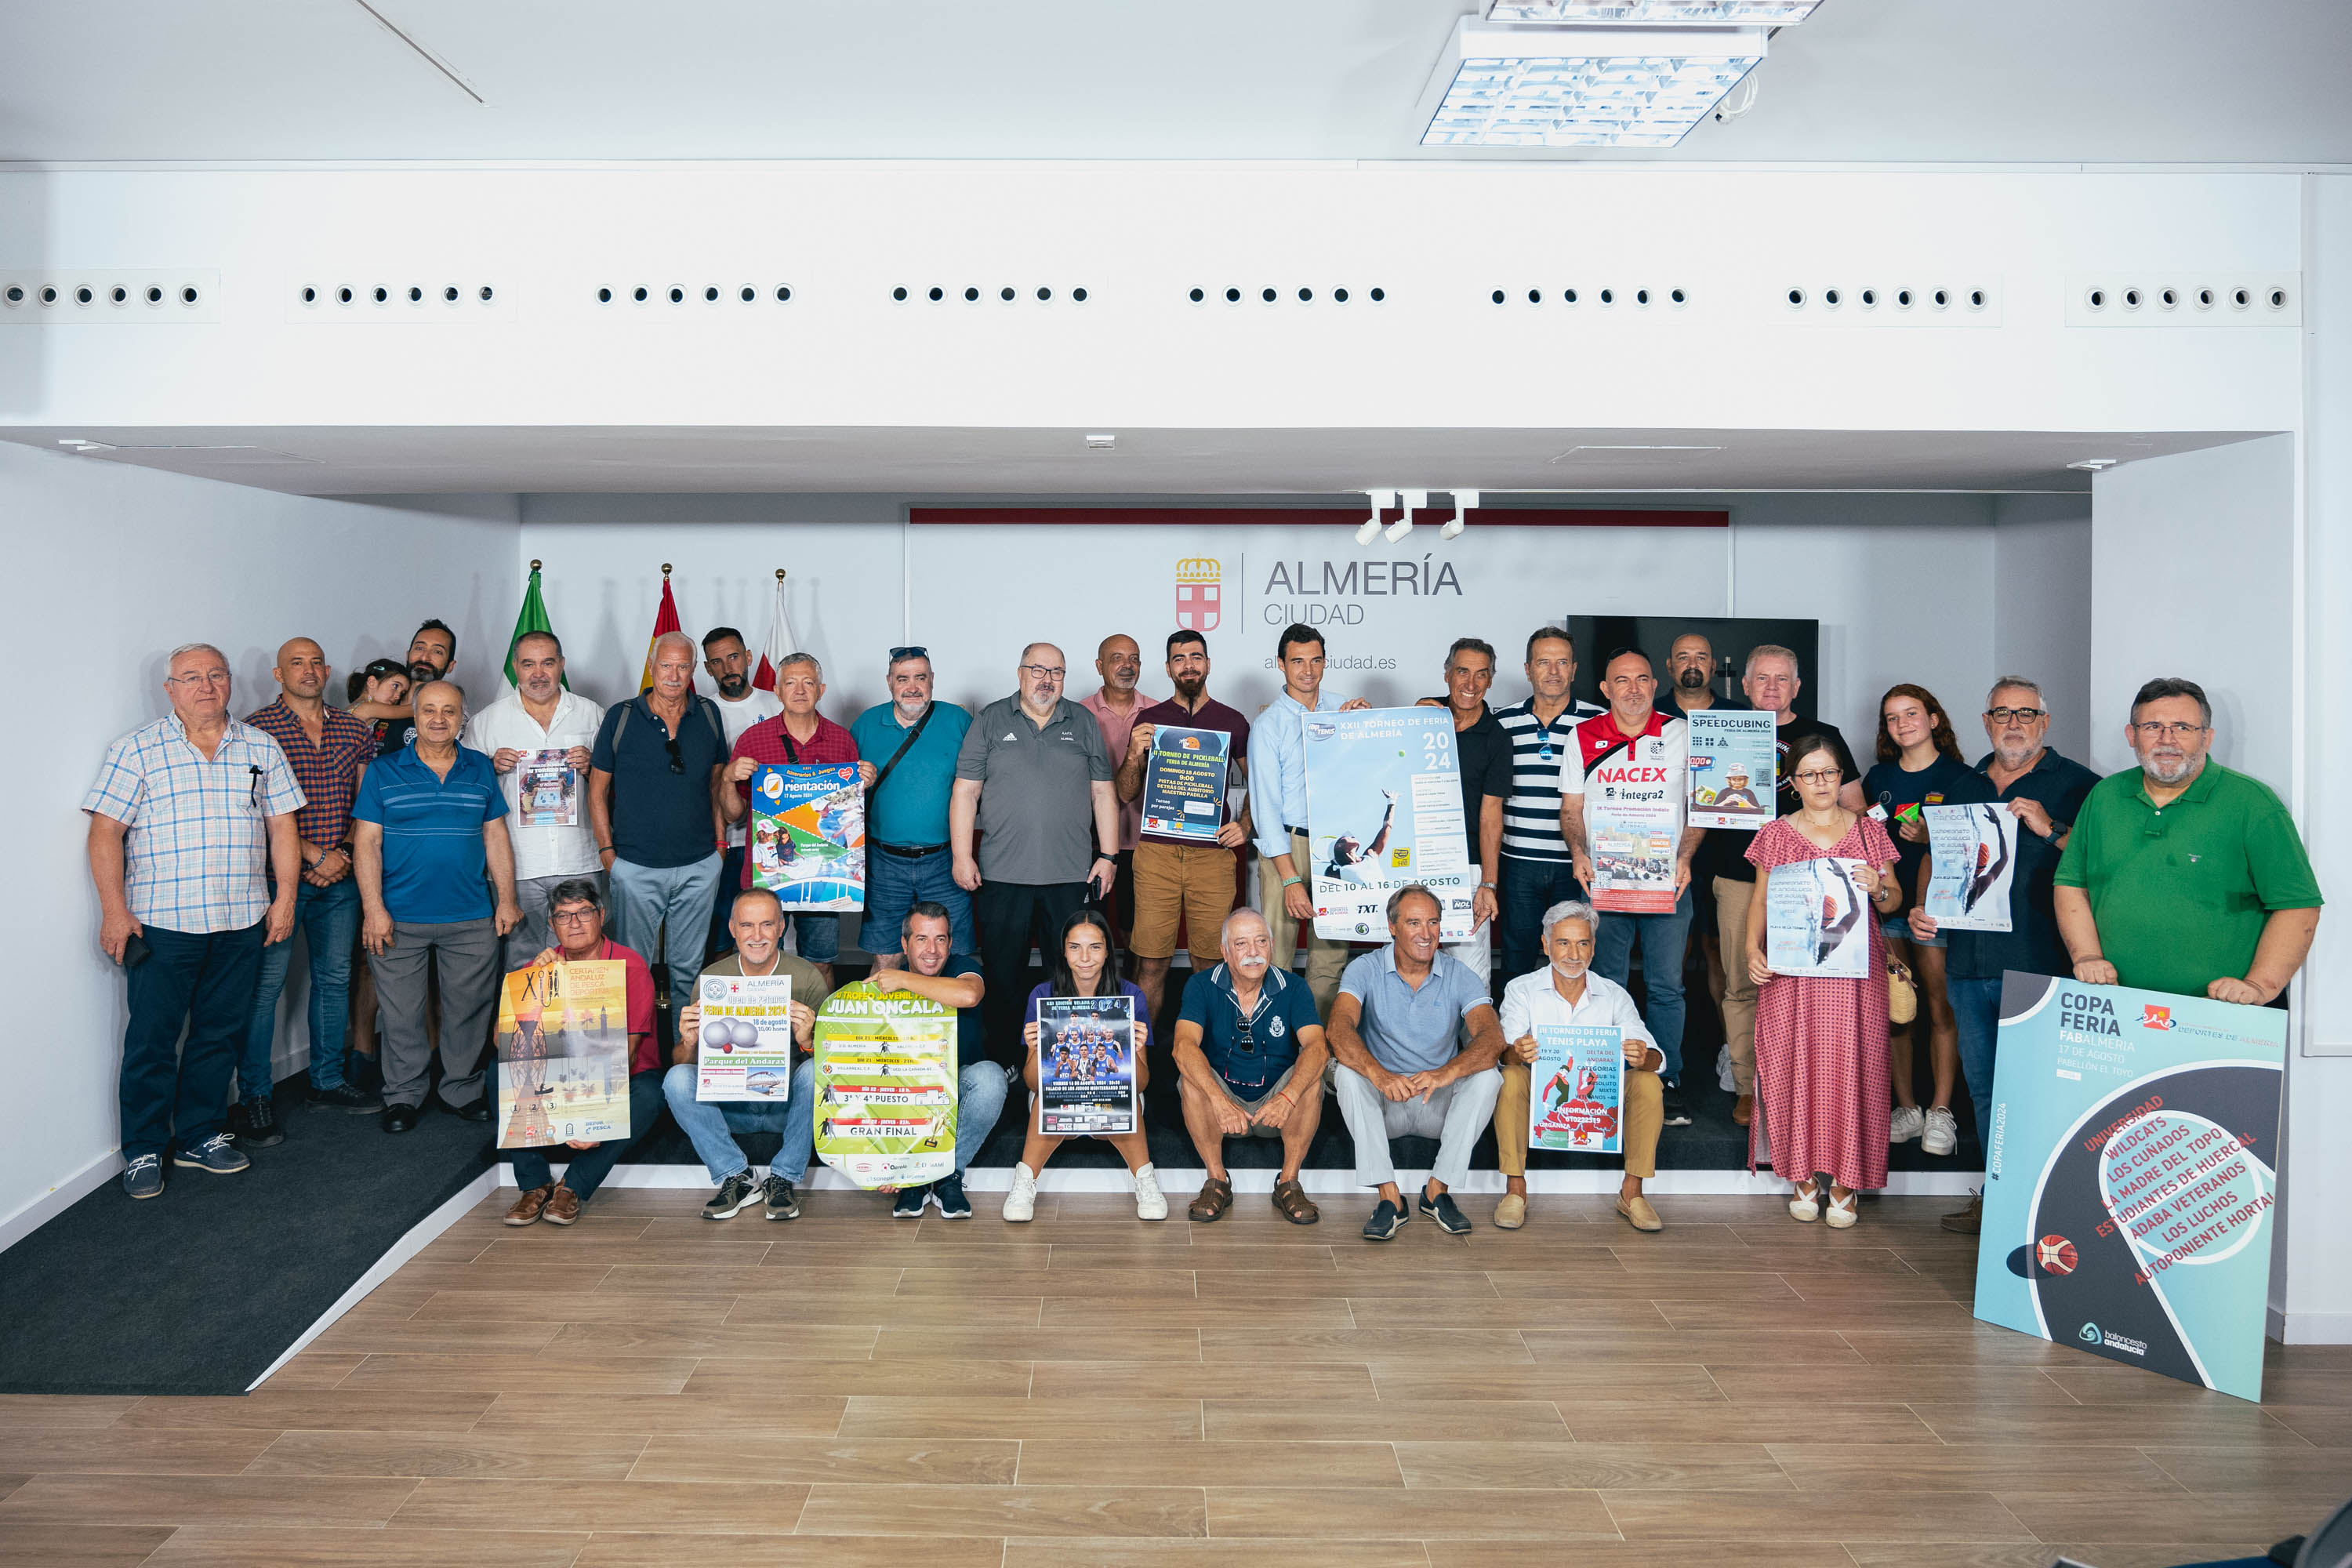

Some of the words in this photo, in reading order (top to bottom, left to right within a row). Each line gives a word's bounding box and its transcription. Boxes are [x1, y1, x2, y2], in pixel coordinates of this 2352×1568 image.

[1264, 552, 1463, 596] ALMERÍA
[1264, 604, 1364, 626] CIUDAD
[1264, 655, 1397, 670] alciudad.es
[1340, 721, 1360, 731] XXII
[1363, 720, 1405, 728] TORNEO
[1424, 717, 1450, 725] FERIA
[1692, 719, 1770, 728] SPEEDCUBING
[1358, 729, 1403, 739] ALMERÍA
[1422, 731, 1449, 750] 20
[1424, 752, 1451, 771] 24
[1597, 767, 1667, 784] NACEX
[1621, 789, 1664, 801] integra2
[1344, 883, 1356, 891] 10
[1361, 882, 1374, 891] AL
[1393, 880, 1408, 889] DE
[1411, 877, 1461, 887] AGOSTO
[843, 991, 875, 1000] TROFEO
[877, 991, 913, 1000] JUVENIL
[1090, 999, 1121, 1010] 2024
[2060, 993, 2114, 1016] COPA
[704, 1005, 723, 1016] FERIA
[724, 1007, 734, 1016] DE
[735, 1004, 767, 1016] ALMERÍA
[768, 1005, 786, 1016] 2024
[827, 1000, 868, 1014] JUAN
[872, 1000, 944, 1014] ONCALA
[2060, 1011, 2122, 1036] FERIA
[2178, 1027, 2223, 1039] DEPORTES
[1546, 1036, 1574, 1046] TENIS
[1577, 1038, 1607, 1047] PLAYA
[2059, 1030, 2136, 1052] FABALMERIA
[2059, 1044, 2070, 1054] 17
[2071, 1047, 2085, 1057] DE
[2087, 1049, 2125, 1064] AGOSTO
[2057, 1057, 2098, 1072] PABELLÓN
[2100, 1065, 2108, 1073] EL
[2113, 1066, 2133, 1077] TOYO
[1557, 1106, 1607, 1115] INFORMACIÓN
[850, 1127, 881, 1136] GRAN
[2084, 1094, 2164, 1152] UNIVERSIDAD
[1991, 1103, 2007, 1181] #COPAFERIA2024
[2104, 1116, 2167, 1160] WILDCATS
[2107, 1162, 2132, 1184] LOS
[2131, 1124, 2190, 1168] CUÑADOS
[2101, 1195, 2120, 1210] LA
[2118, 1165, 2163, 1200] MADRE
[2161, 1151, 2189, 1171] DEL
[2186, 1127, 2222, 1155] TOPO
[2095, 1179, 2179, 1239] ESTUDIANTES
[2178, 1167, 2198, 1185] DE
[2195, 1132, 2256, 1174] HUERCAL
[2131, 1208, 2173, 1240] ADABA
[2170, 1160, 2247, 1212] VETERANOS
[2161, 1221, 2188, 1243] LOS
[2186, 1190, 2239, 1228] LUCHOS
[2134, 1221, 2229, 1286] AUTOPONIENTE
[2104, 1330, 2147, 1349] baloncesto
[2104, 1339, 2145, 1356] andalucia
